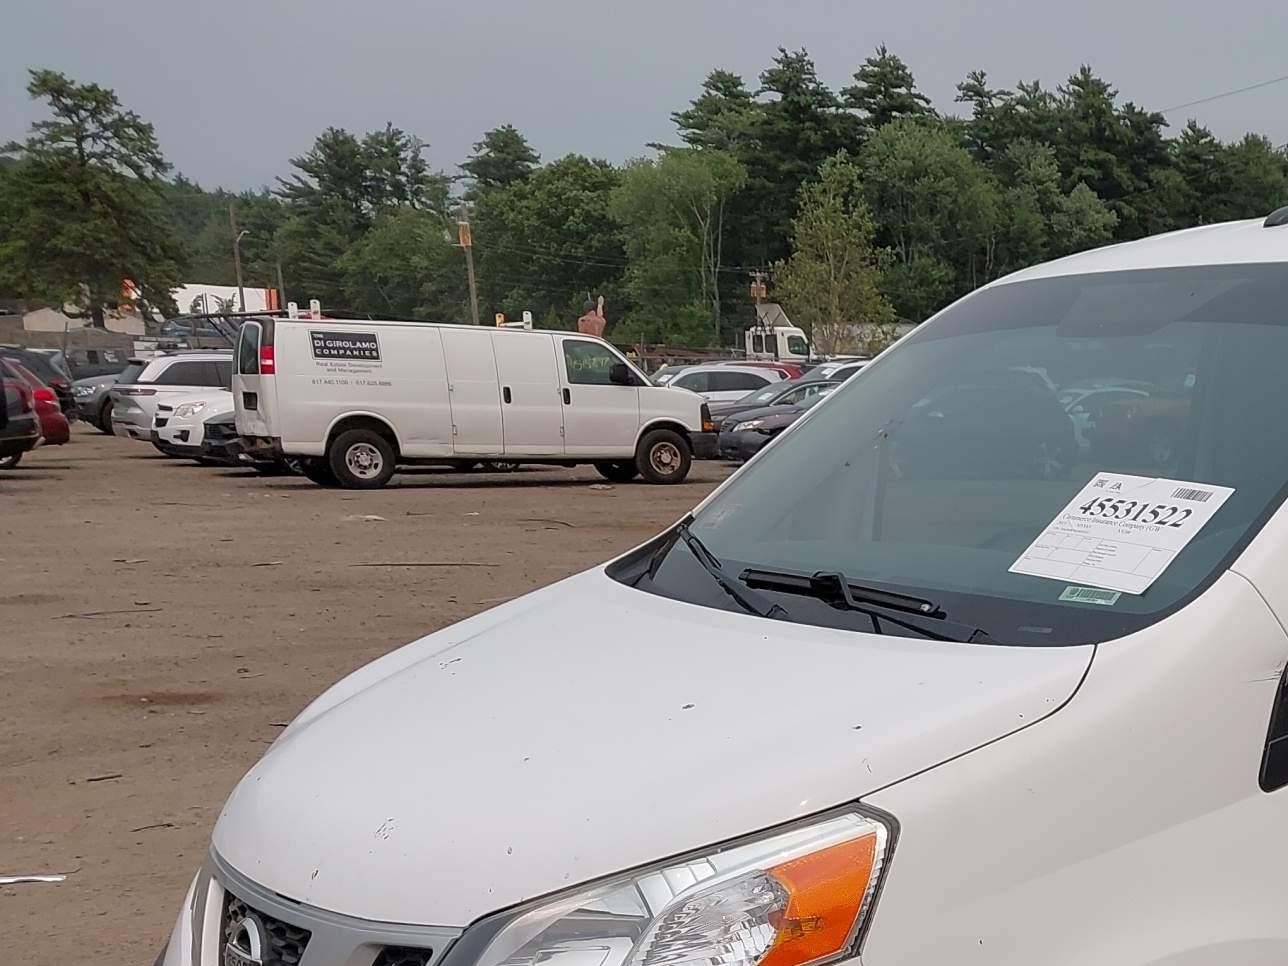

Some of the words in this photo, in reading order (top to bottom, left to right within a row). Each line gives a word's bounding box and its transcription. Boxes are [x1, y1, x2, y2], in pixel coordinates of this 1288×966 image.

[326, 340, 377, 348] GIROLAMO
[316, 348, 378, 356] COMPANIES
[1079, 497, 1193, 527] 45531522
[1092, 517, 1116, 526] Insurance
[1118, 521, 1145, 531] Company
